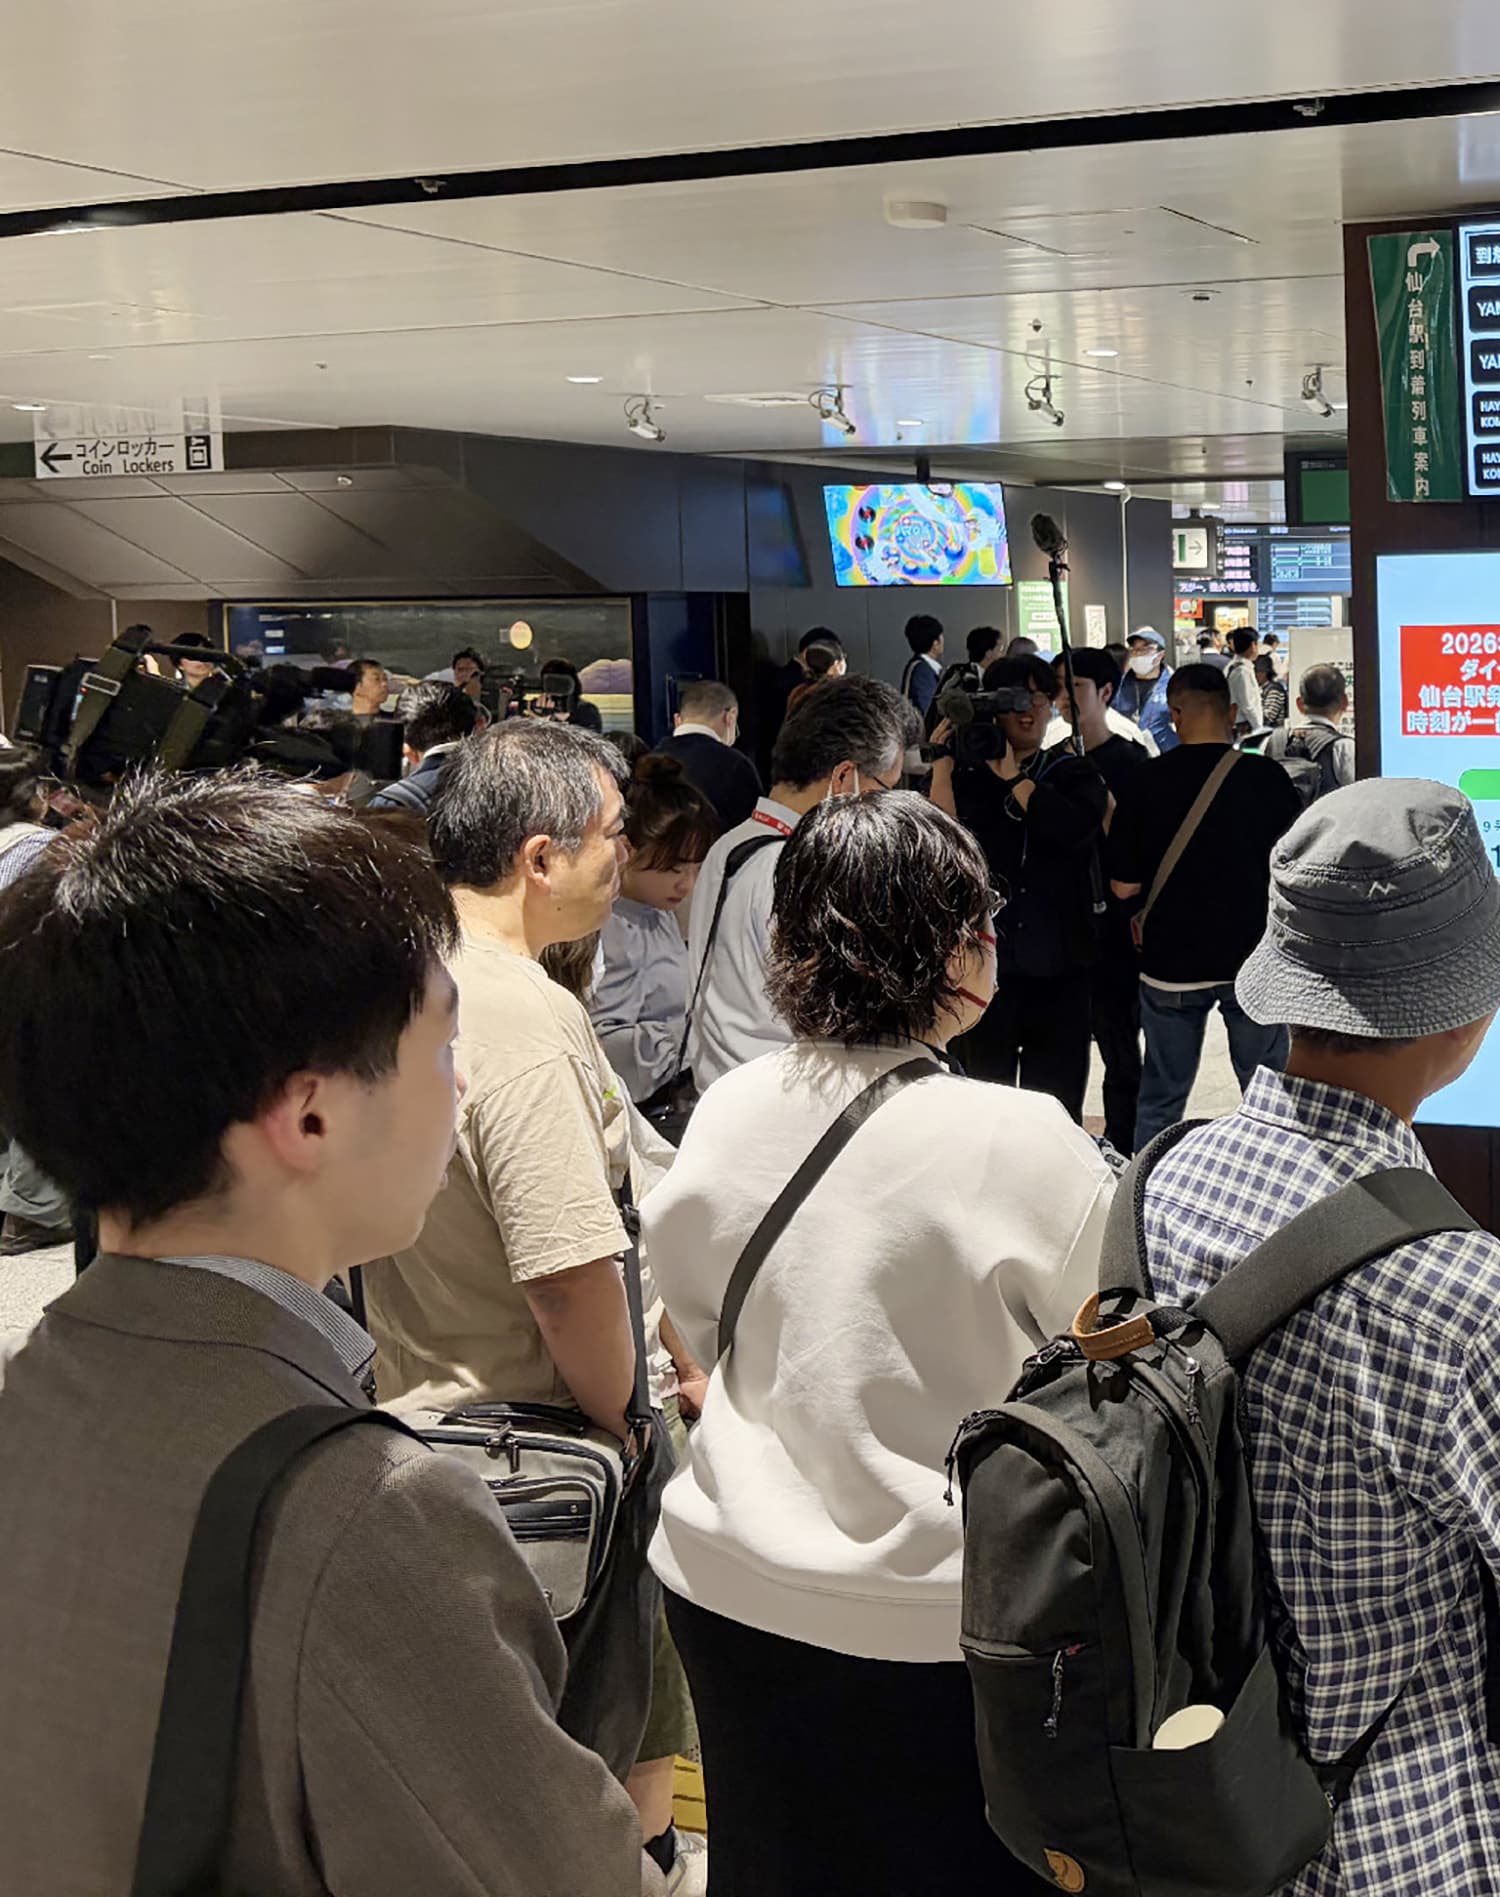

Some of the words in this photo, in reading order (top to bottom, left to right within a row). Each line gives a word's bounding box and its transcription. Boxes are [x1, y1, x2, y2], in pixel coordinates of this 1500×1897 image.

[1405, 271, 1430, 497] 仙台駅到着列車案内
[76, 437, 175, 459] コインロッカー
[82, 459, 113, 475] Coin
[123, 457, 175, 474] Lockers
